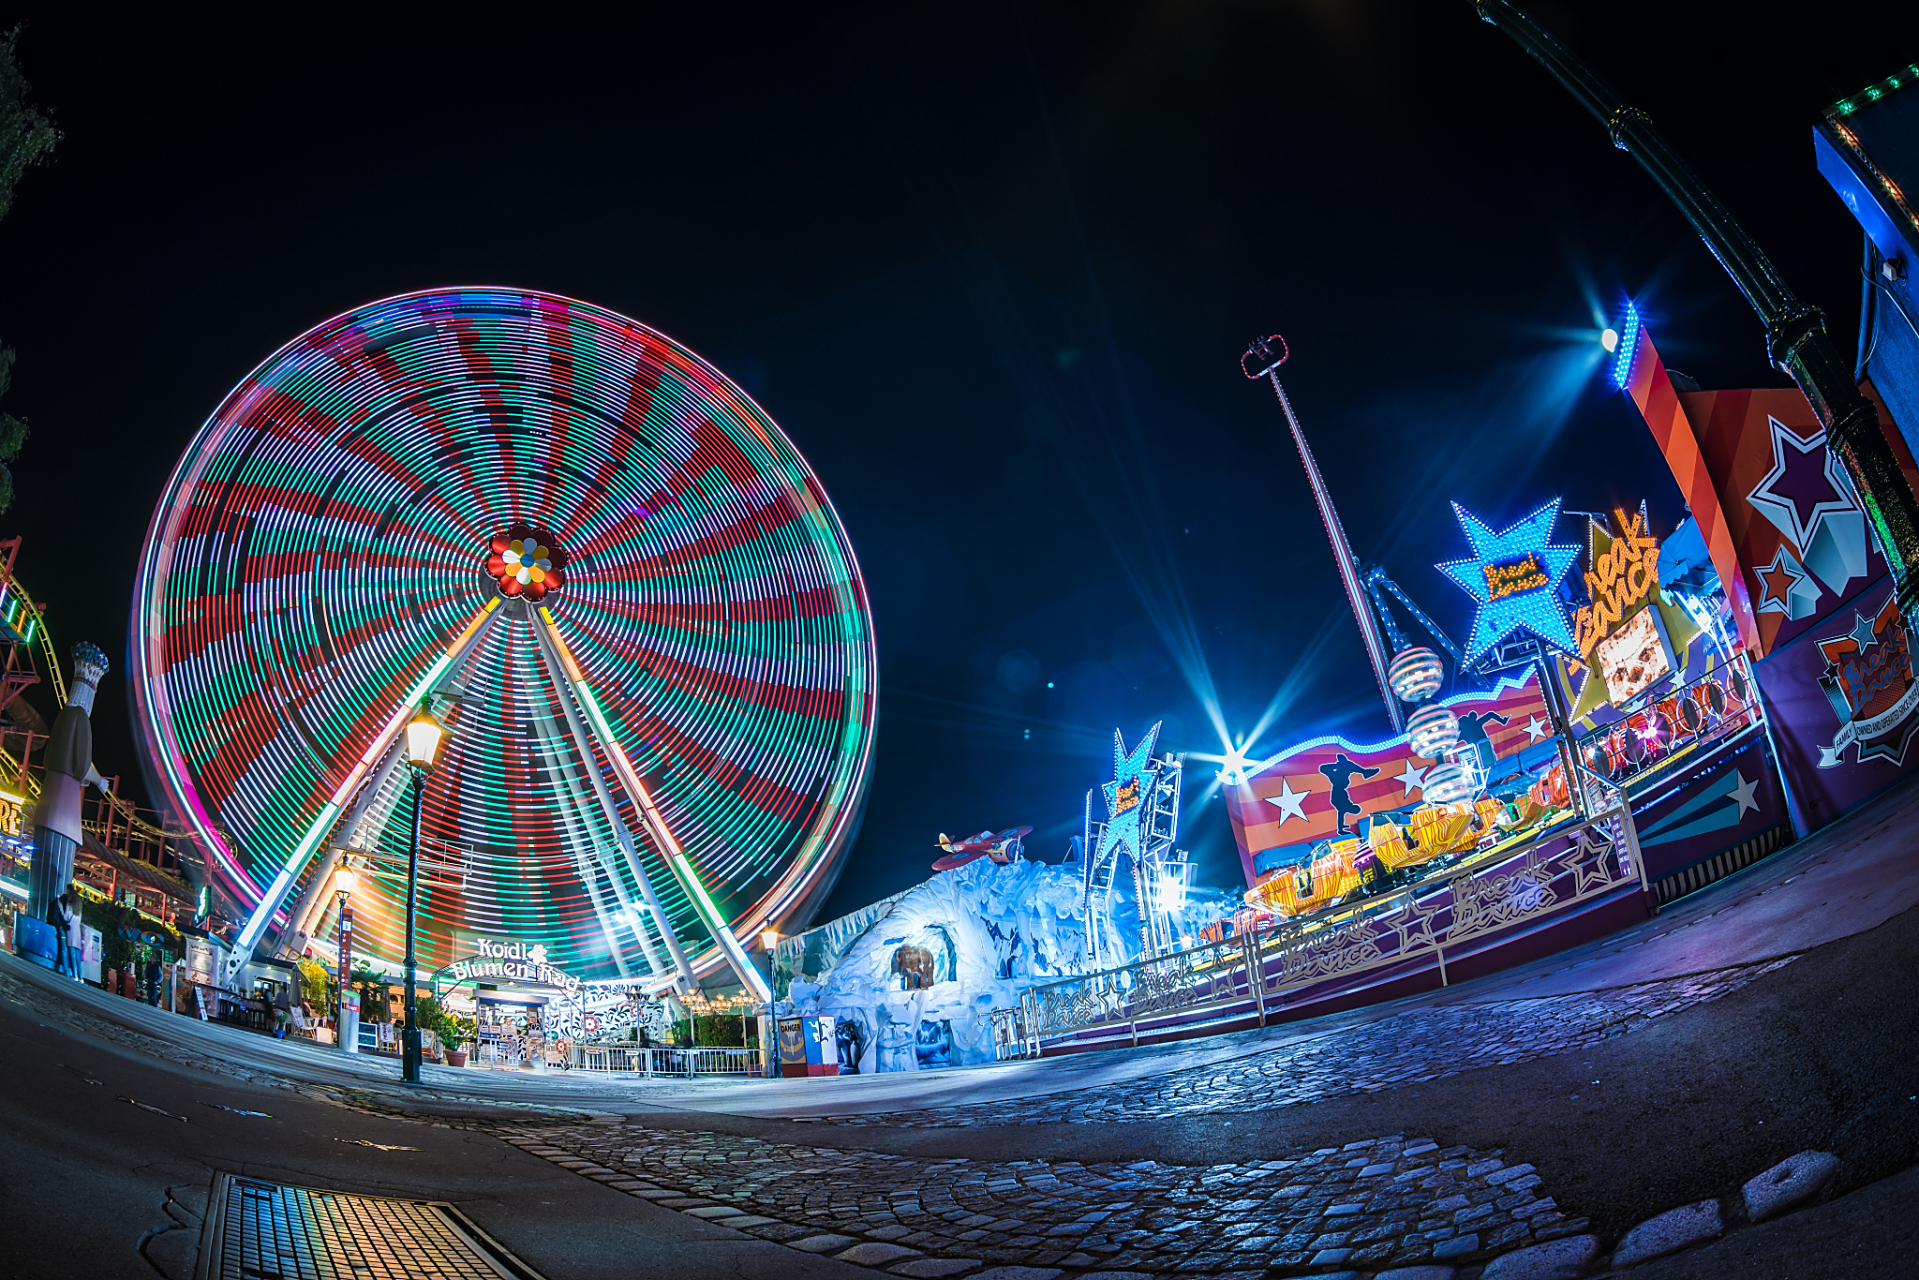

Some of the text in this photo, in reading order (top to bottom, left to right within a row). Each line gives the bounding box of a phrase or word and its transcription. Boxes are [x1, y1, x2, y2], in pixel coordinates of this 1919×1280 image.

[1483, 551, 1542, 584] Break
[1487, 573, 1549, 602] Dance
[1844, 626, 1904, 685] Break
[1850, 653, 1912, 717] Dance
[1836, 728, 1852, 750] FAMILY
[1857, 724, 1872, 736] OWNED
[1881, 709, 1900, 728] OPERATED
[1899, 699, 1910, 716] SINCE
[1449, 849, 1553, 904] Break
[1447, 887, 1557, 939] Dance
[118, 923, 164, 950] WC
[1281, 908, 1379, 955] Break
[477, 938, 528, 960] Koidl
[1278, 943, 1381, 985] Dance
[453, 960, 580, 994] Blumen Rad
[1134, 956, 1194, 999] Break
[1044, 980, 1093, 1010] Break
[1133, 988, 1198, 1016] Dance
[780, 1024, 801, 1033] DANGER
[1043, 1007, 1095, 1029] Dance
